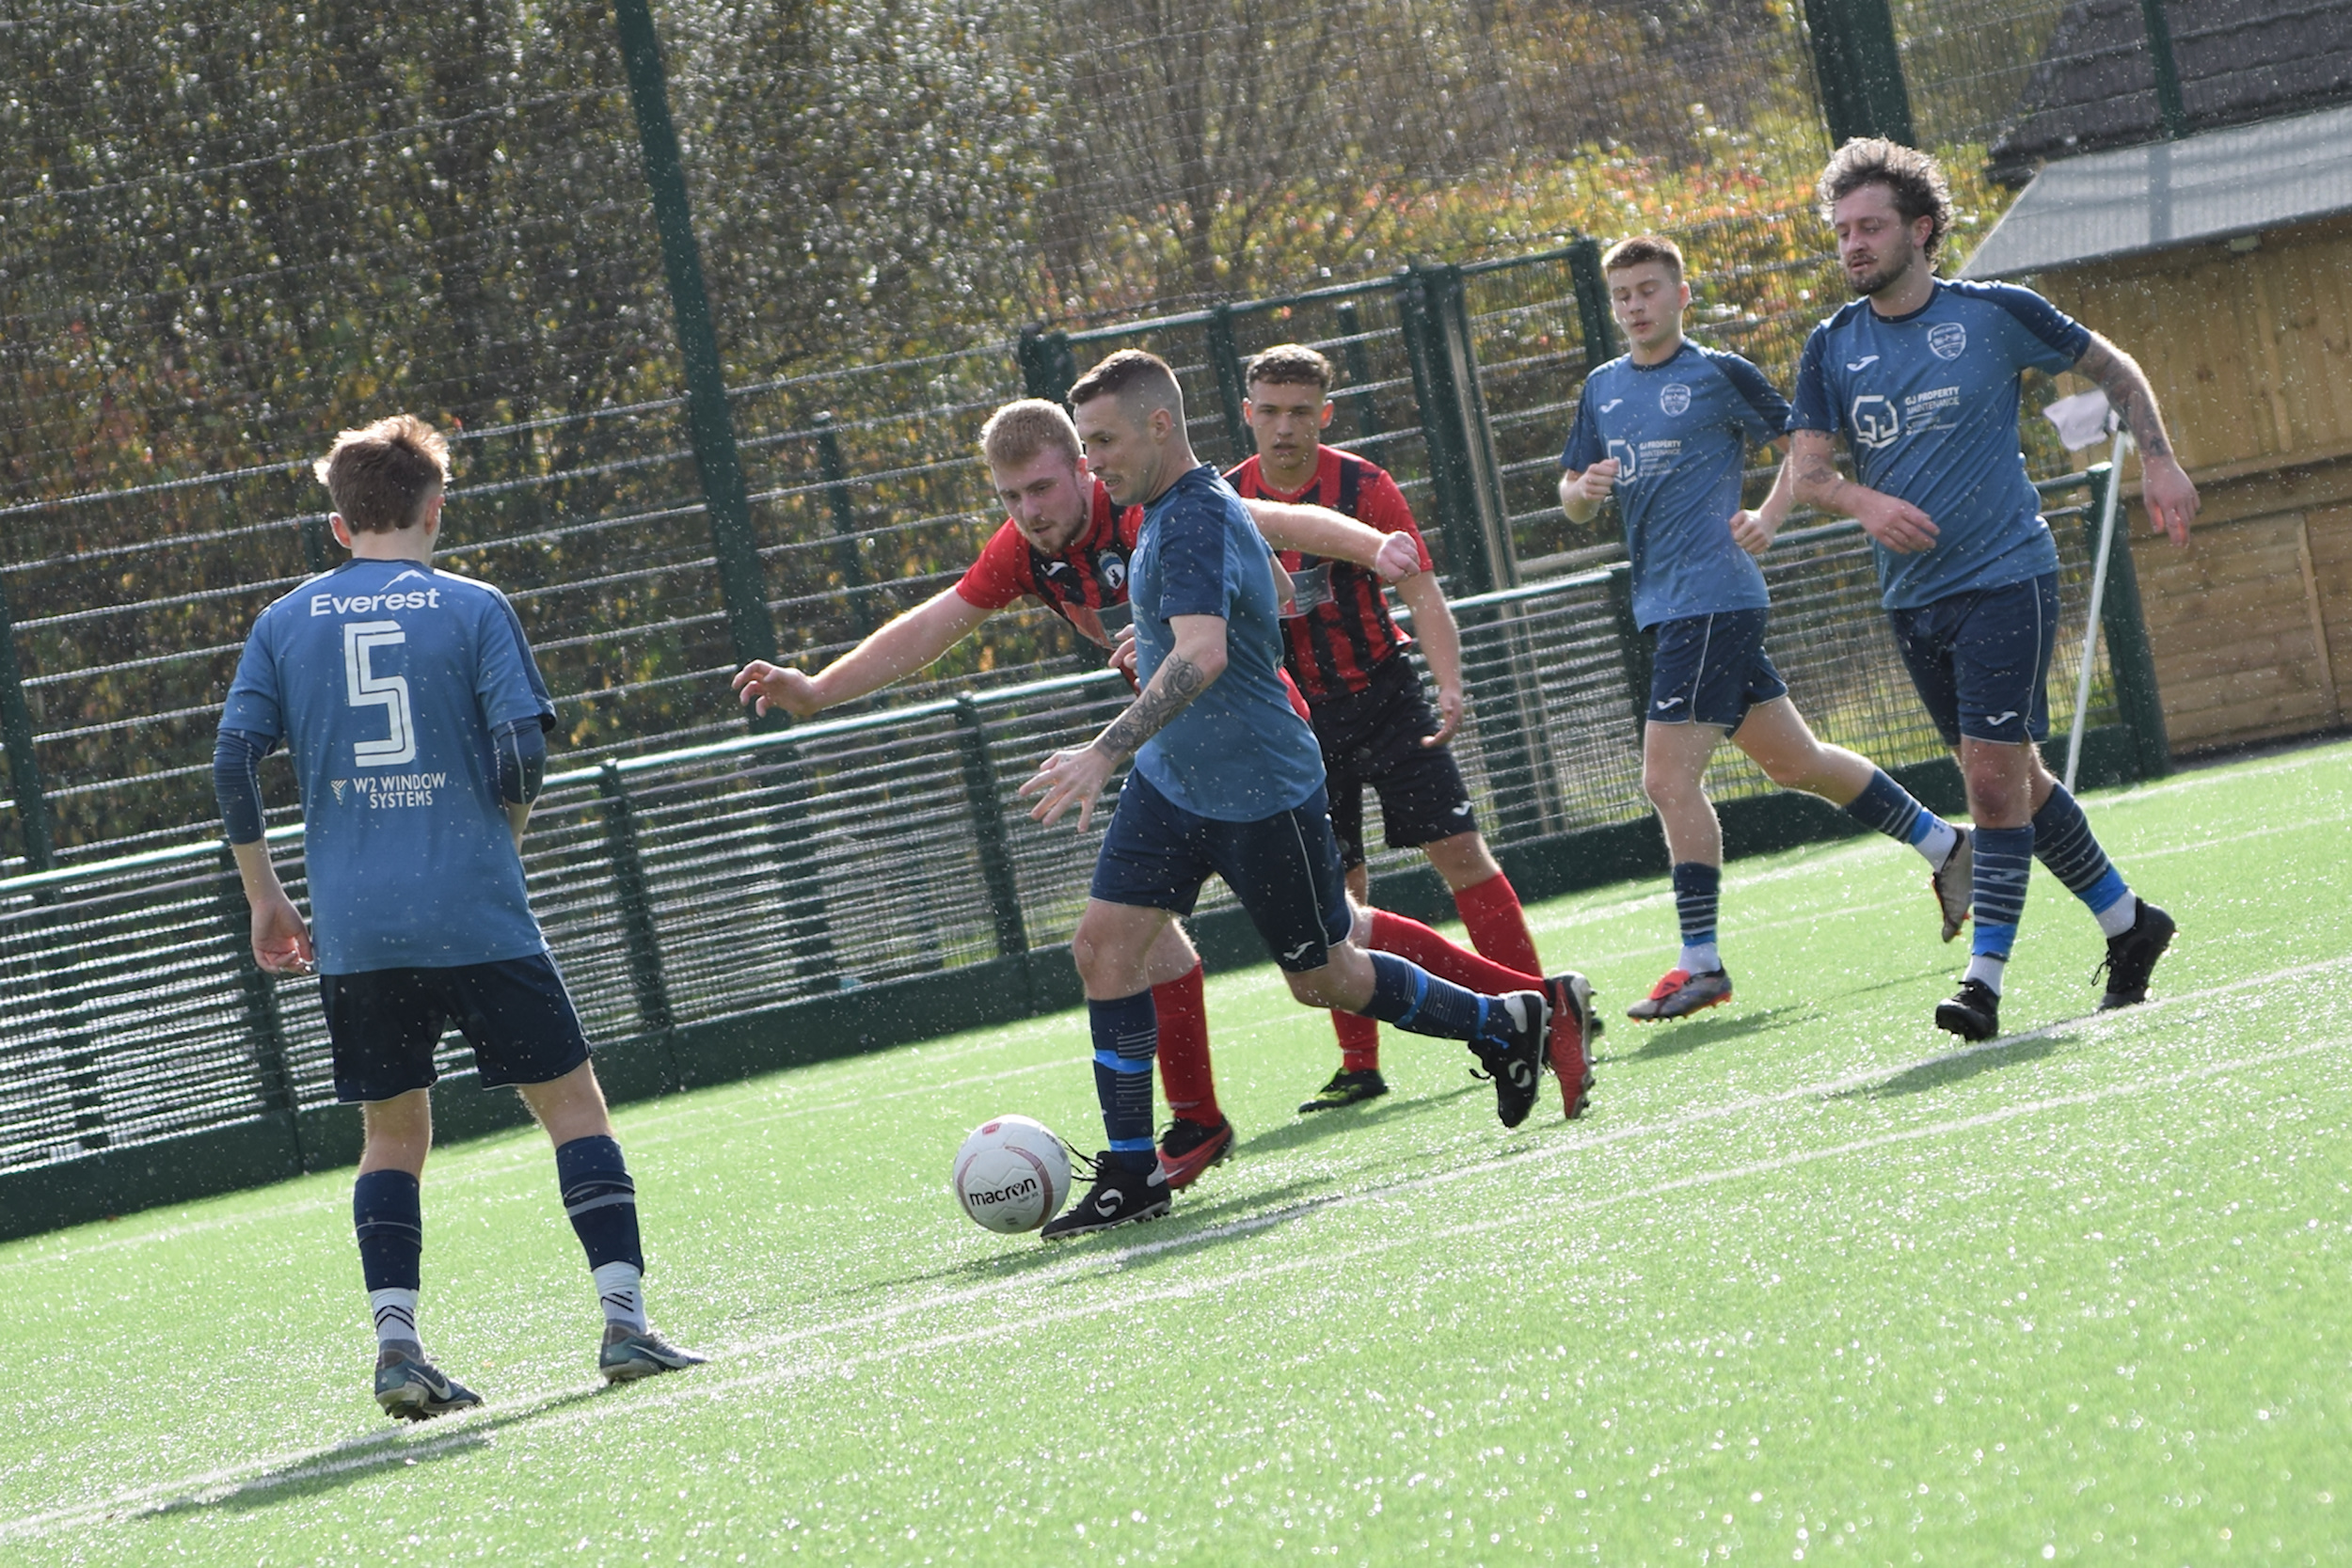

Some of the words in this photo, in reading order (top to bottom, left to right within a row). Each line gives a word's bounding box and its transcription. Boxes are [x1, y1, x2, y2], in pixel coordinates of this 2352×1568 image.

[1904, 396, 1917, 405] GJ
[1917, 386, 1961, 402] PROPERTY
[1906, 396, 1961, 414] MAINTENANCE
[1647, 439, 1682, 449] PROPERTY
[310, 588, 441, 617] Everest
[343, 620, 417, 768] 5
[353, 777, 378, 794] W2
[380, 772, 447, 791] WINDOW
[370, 790, 434, 810] SYSTEMS
[969, 1178, 1038, 1206] macron
